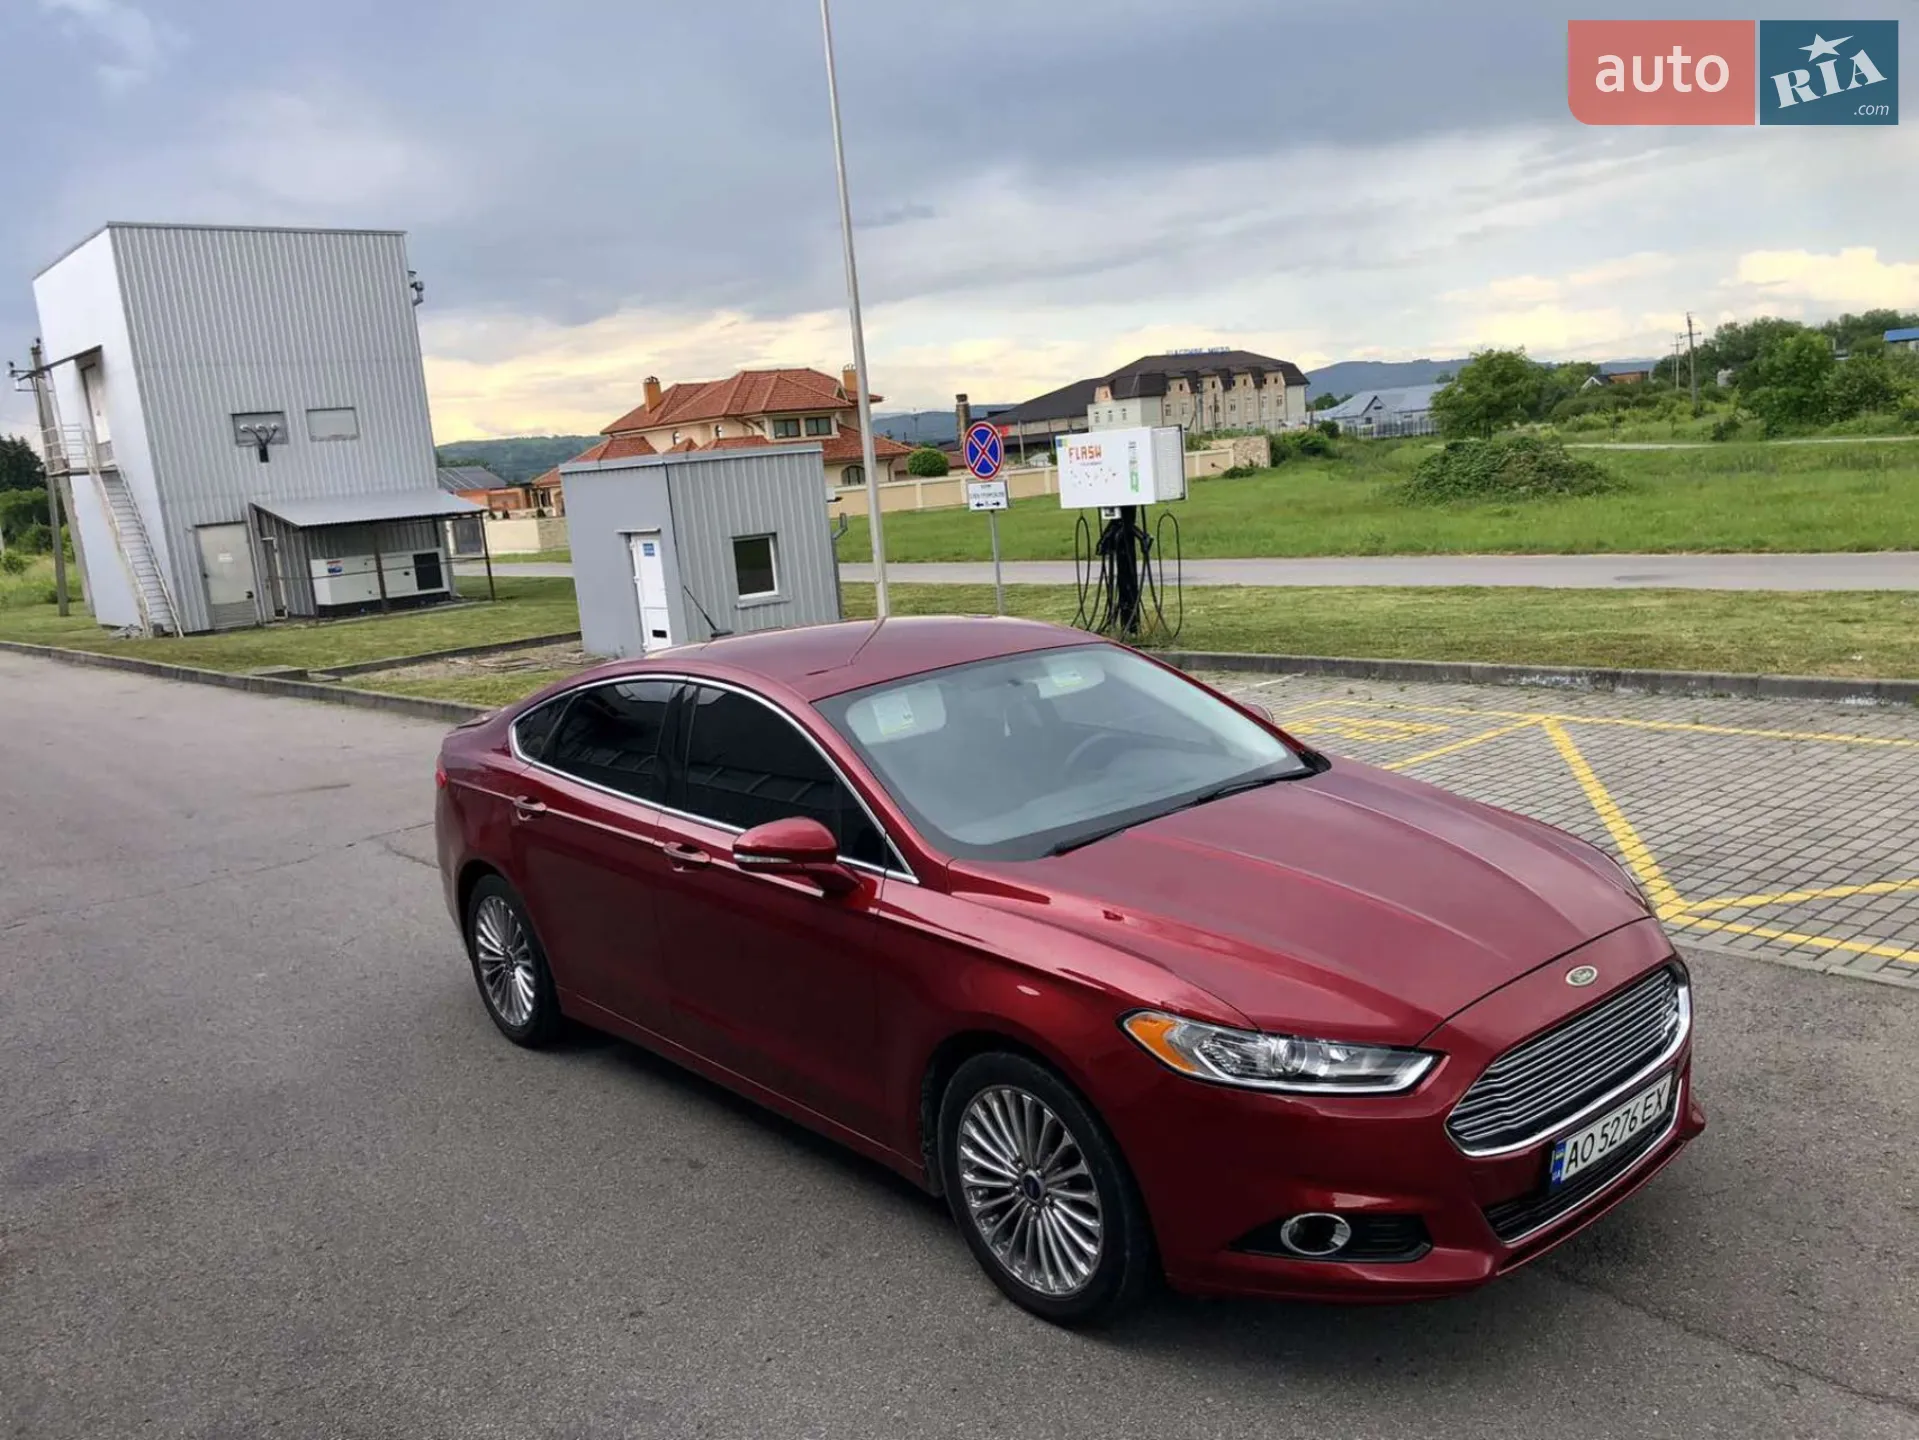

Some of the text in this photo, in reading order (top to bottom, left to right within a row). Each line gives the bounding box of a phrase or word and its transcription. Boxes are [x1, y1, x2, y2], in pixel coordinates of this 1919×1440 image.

[1565, 1082, 1667, 1174] AO 5276 EX
